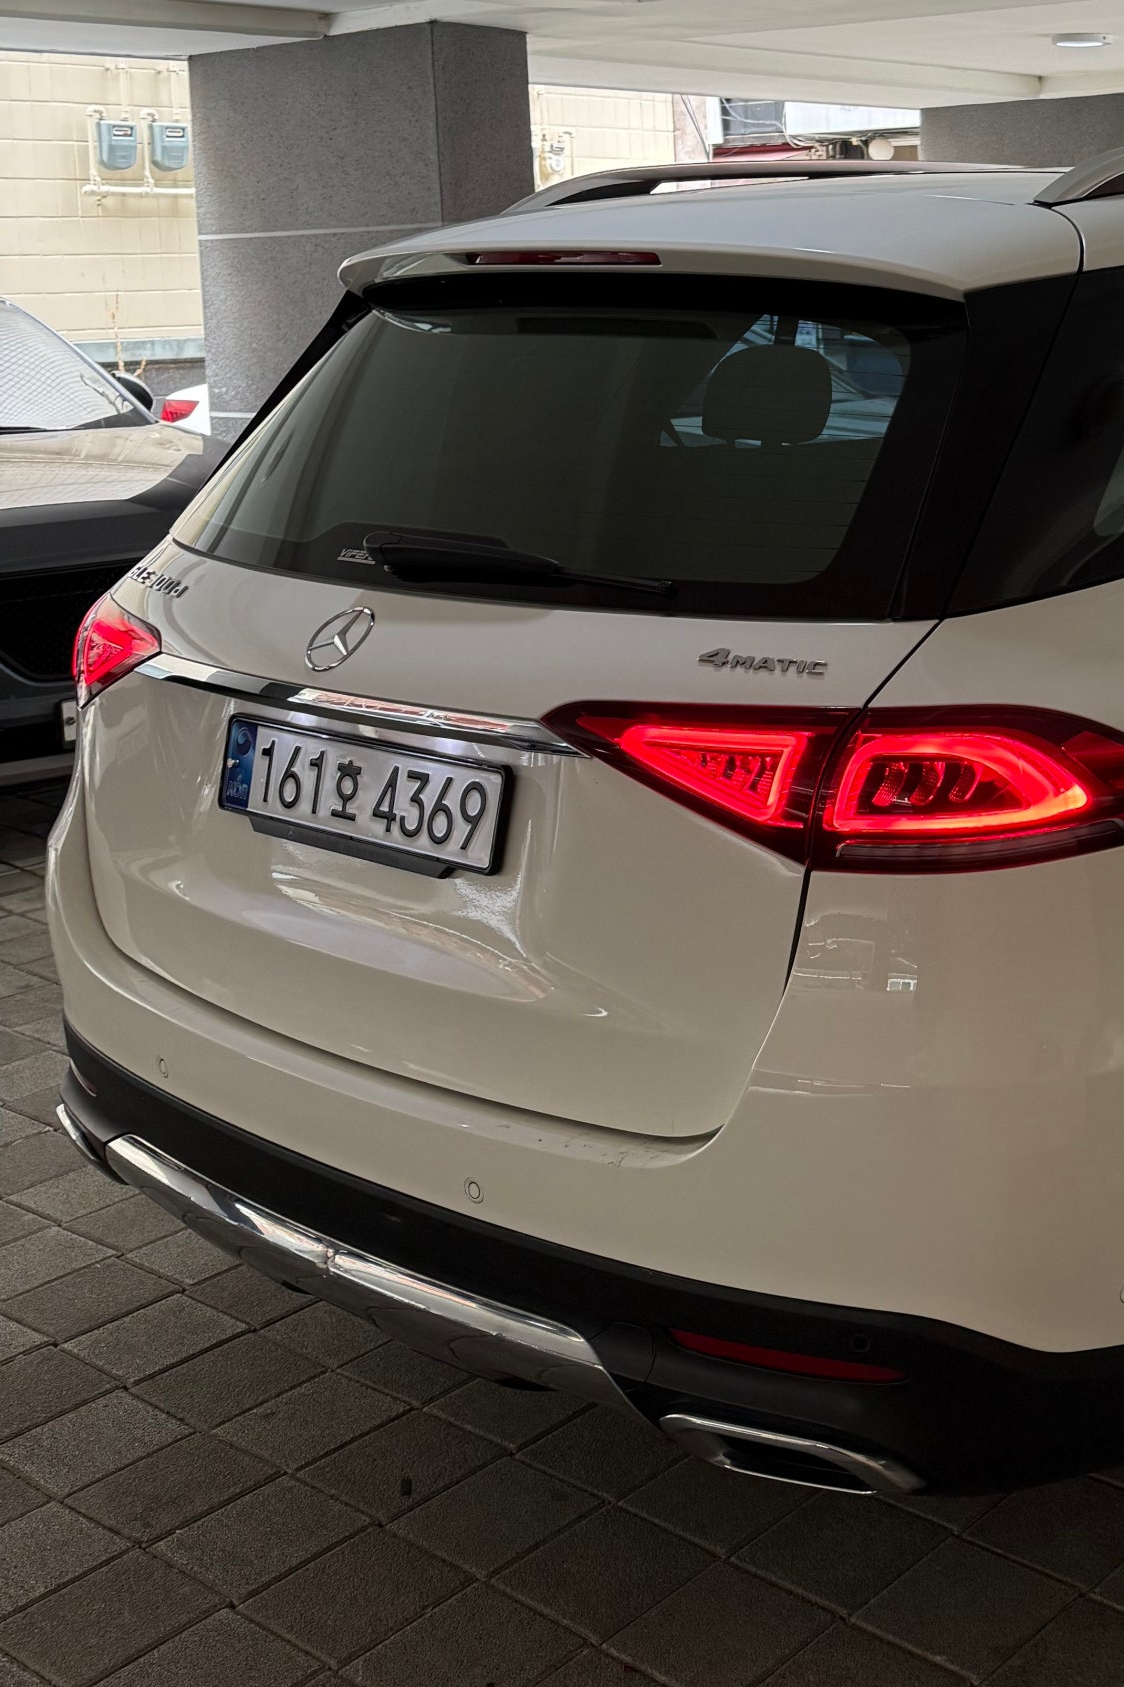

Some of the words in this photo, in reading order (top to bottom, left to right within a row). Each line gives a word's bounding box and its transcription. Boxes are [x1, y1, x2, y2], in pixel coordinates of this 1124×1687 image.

[697, 647, 828, 675] 4MATIC
[226, 780, 249, 800] KOR
[261, 739, 362, 822] 161호
[372, 765, 487, 850] 4369
